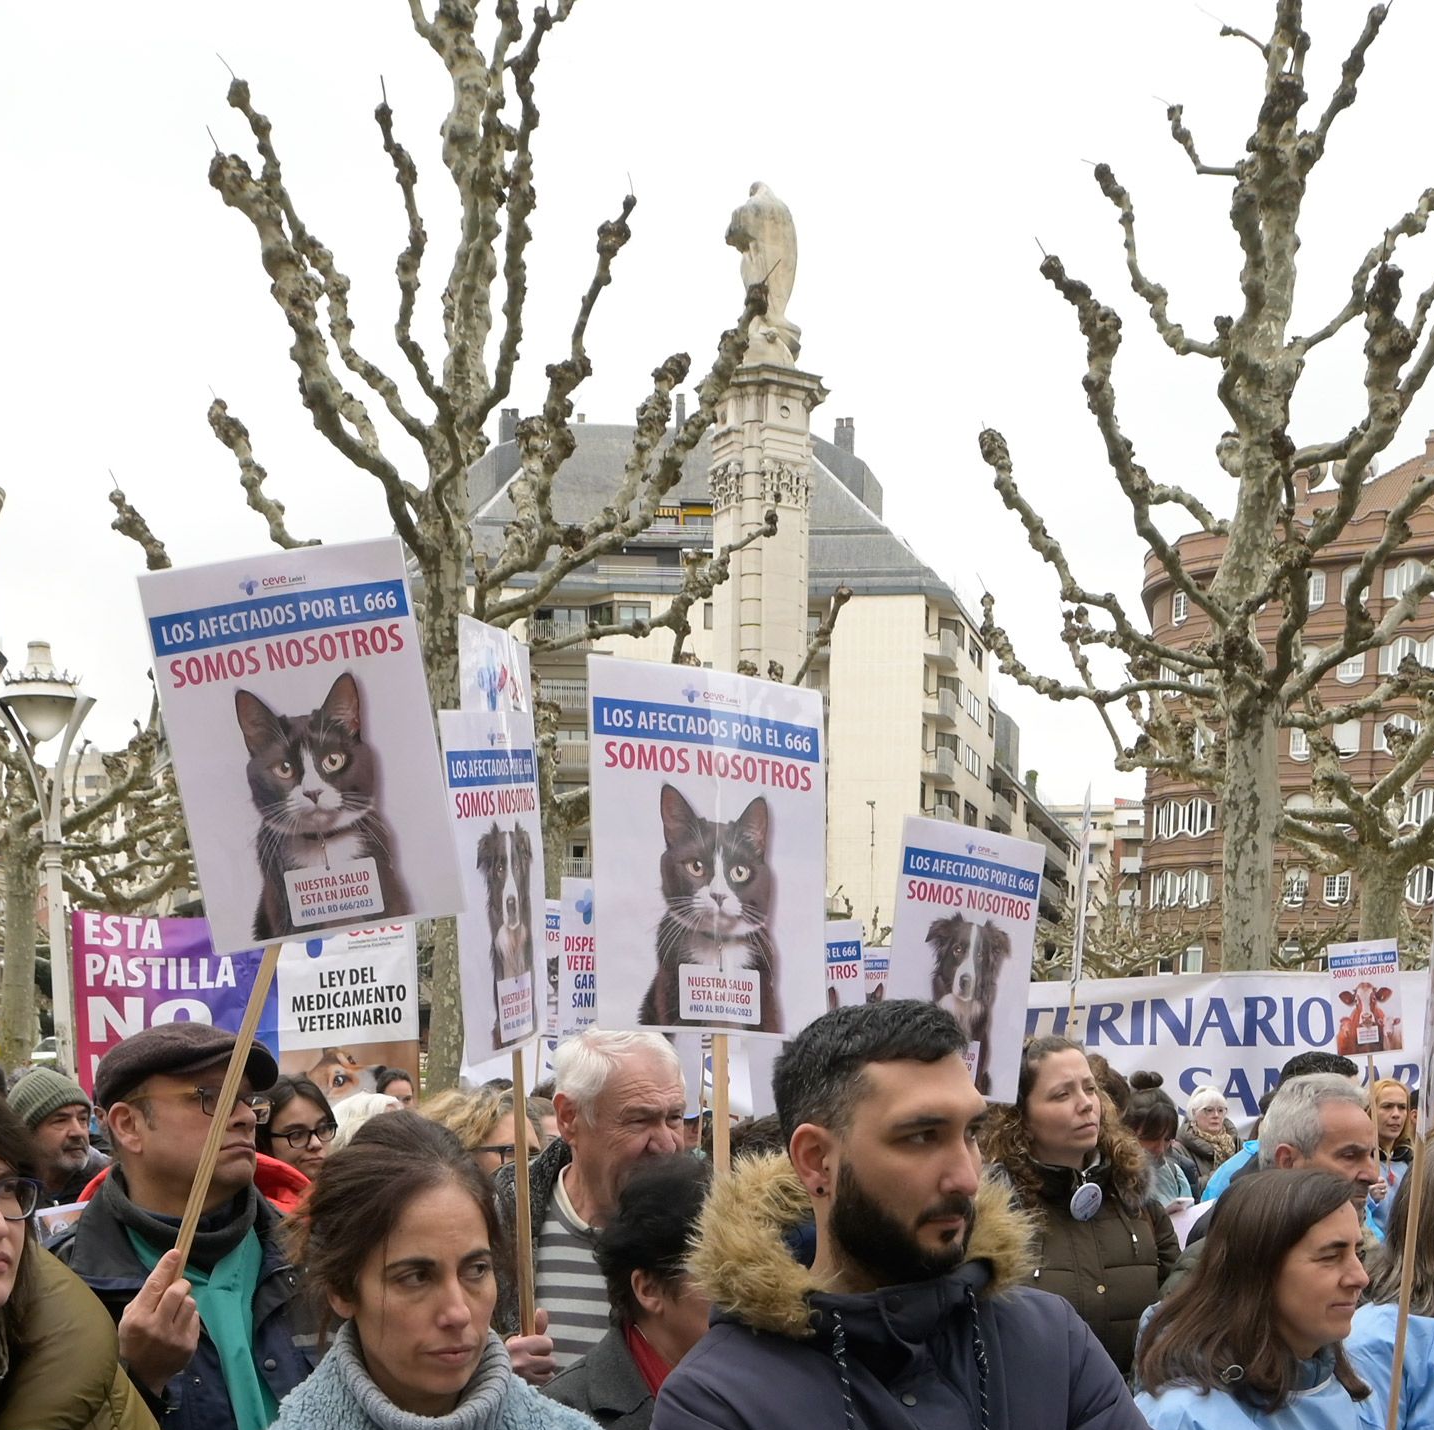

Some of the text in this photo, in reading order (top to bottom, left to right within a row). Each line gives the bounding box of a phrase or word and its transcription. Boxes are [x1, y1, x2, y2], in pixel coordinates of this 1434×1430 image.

[261, 574, 287, 588] ceve
[160, 590, 397, 646] LOS AFECTADOS POR EL 666
[169, 623, 404, 689] SOMOS NOSOTROS
[603, 707, 812, 753] LOS AFECTADOS POR EL 666
[451, 759, 467, 779] LOS
[468, 758, 509, 778] AFECTADOS
[604, 741, 812, 793] SOMOS NOSOTROS
[455, 787, 535, 820] SOMOS NOSOTROS
[294, 871, 370, 893] NUESTRA SALUD
[909, 854, 1034, 893] LOS AFECTADOS POR EL 666
[300, 884, 369, 906] ESTA EN JUEGO
[317, 906, 327, 915] AL
[328, 903, 338, 913] RD
[339, 899, 374, 912] 666/2023
[907, 879, 1031, 921] SOMOS NOSOTROS
[83, 913, 163, 950] ESTA
[831, 947, 841, 958] EL
[842, 946, 857, 957] 666
[84, 953, 237, 990] PASTILLA
[319, 966, 377, 989] LEY DEL
[688, 976, 753, 992] NUESTRA SALUD
[1333, 964, 1395, 979] SOMOS NOSOTROS
[291, 984, 407, 1013] MEDICAMENTO
[691, 990, 750, 1005] ESTA EN JUEGO
[297, 1006, 402, 1033] VETERINARIO
